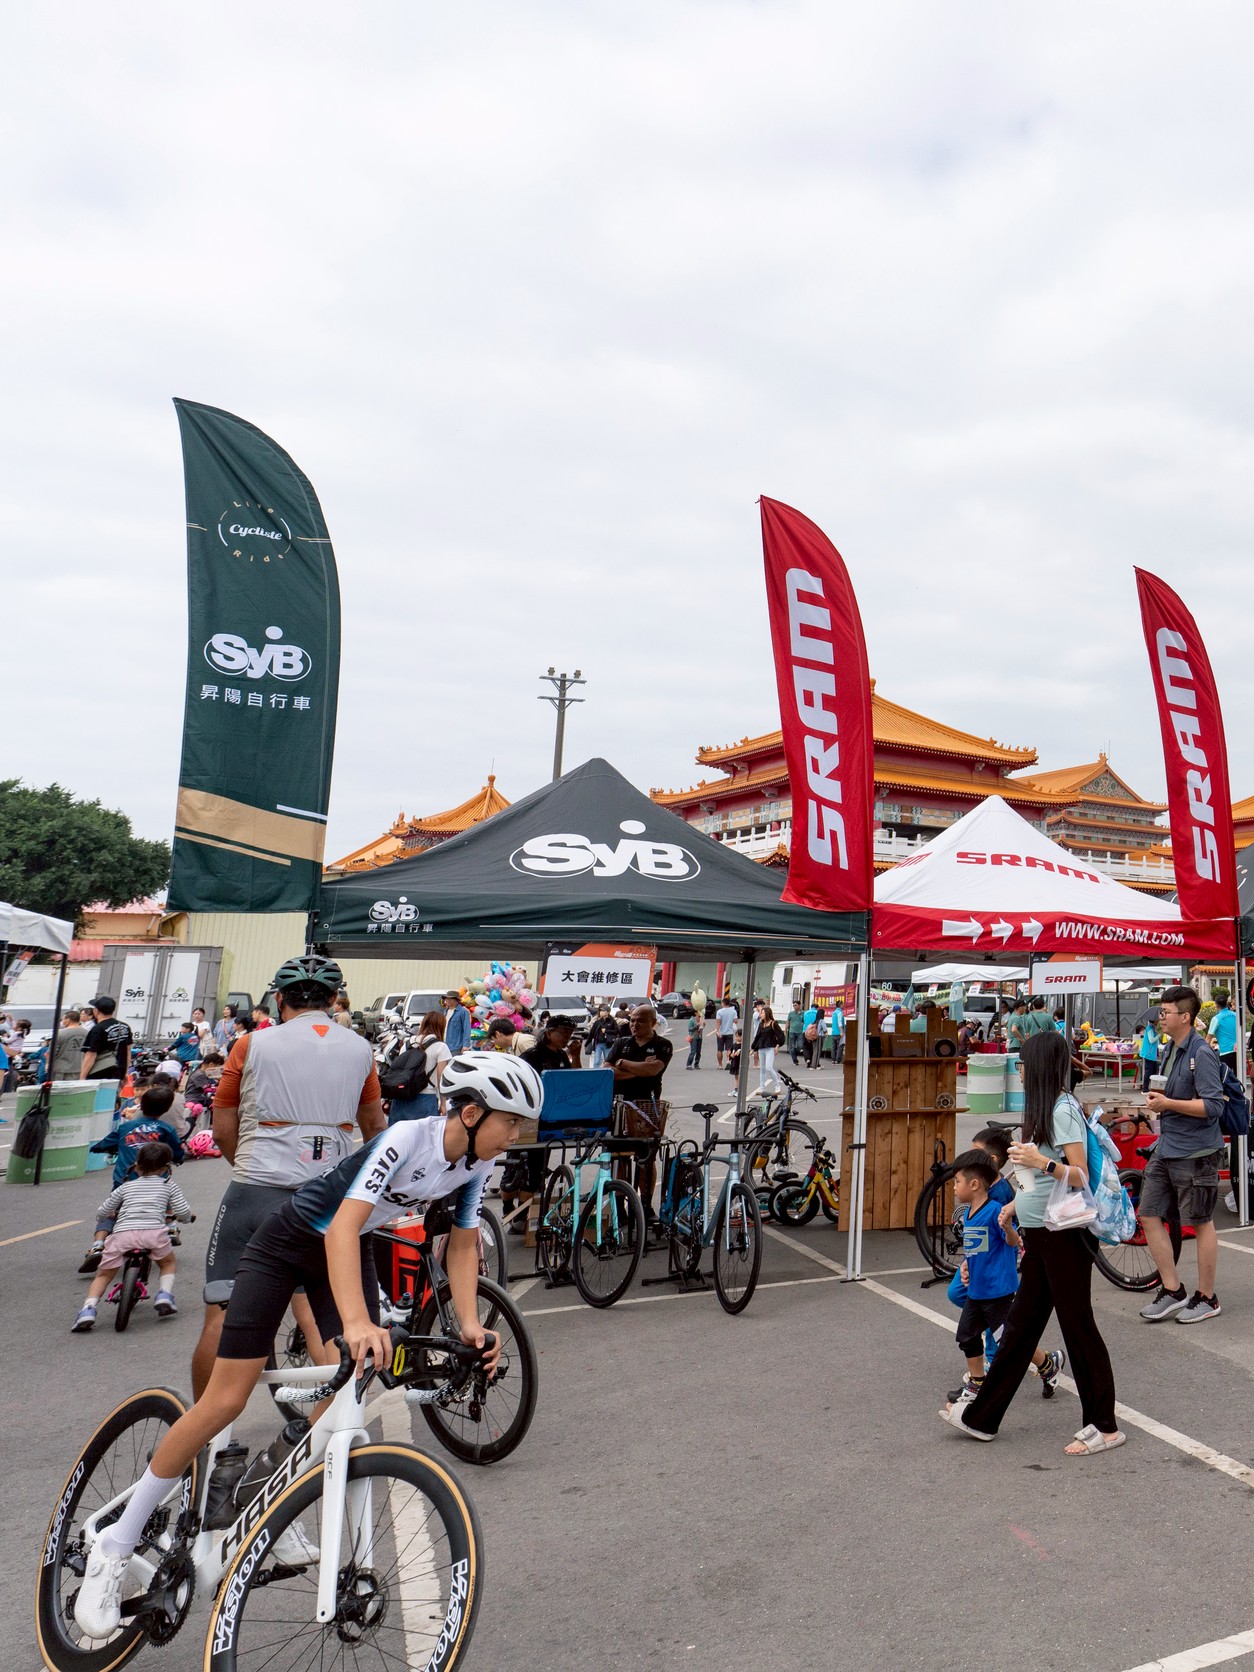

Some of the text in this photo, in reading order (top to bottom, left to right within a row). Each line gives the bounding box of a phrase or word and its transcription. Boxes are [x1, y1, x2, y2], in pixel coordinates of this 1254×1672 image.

[229, 524, 283, 541] Cycliste
[200, 684, 311, 710] 昇陽自行車
[785, 568, 849, 871] SRAM
[1156, 627, 1221, 884] SRAM
[957, 851, 1101, 883] SRAM
[366, 924, 434, 933] 昇陽自行車
[1054, 920, 1185, 947] WWW.SRAM.COM
[561, 970, 634, 984] 大會維修區
[881, 982, 892, 990] 60
[1044, 975, 1087, 983] SRAM
[208, 1205, 226, 1266] UNLEASHED
